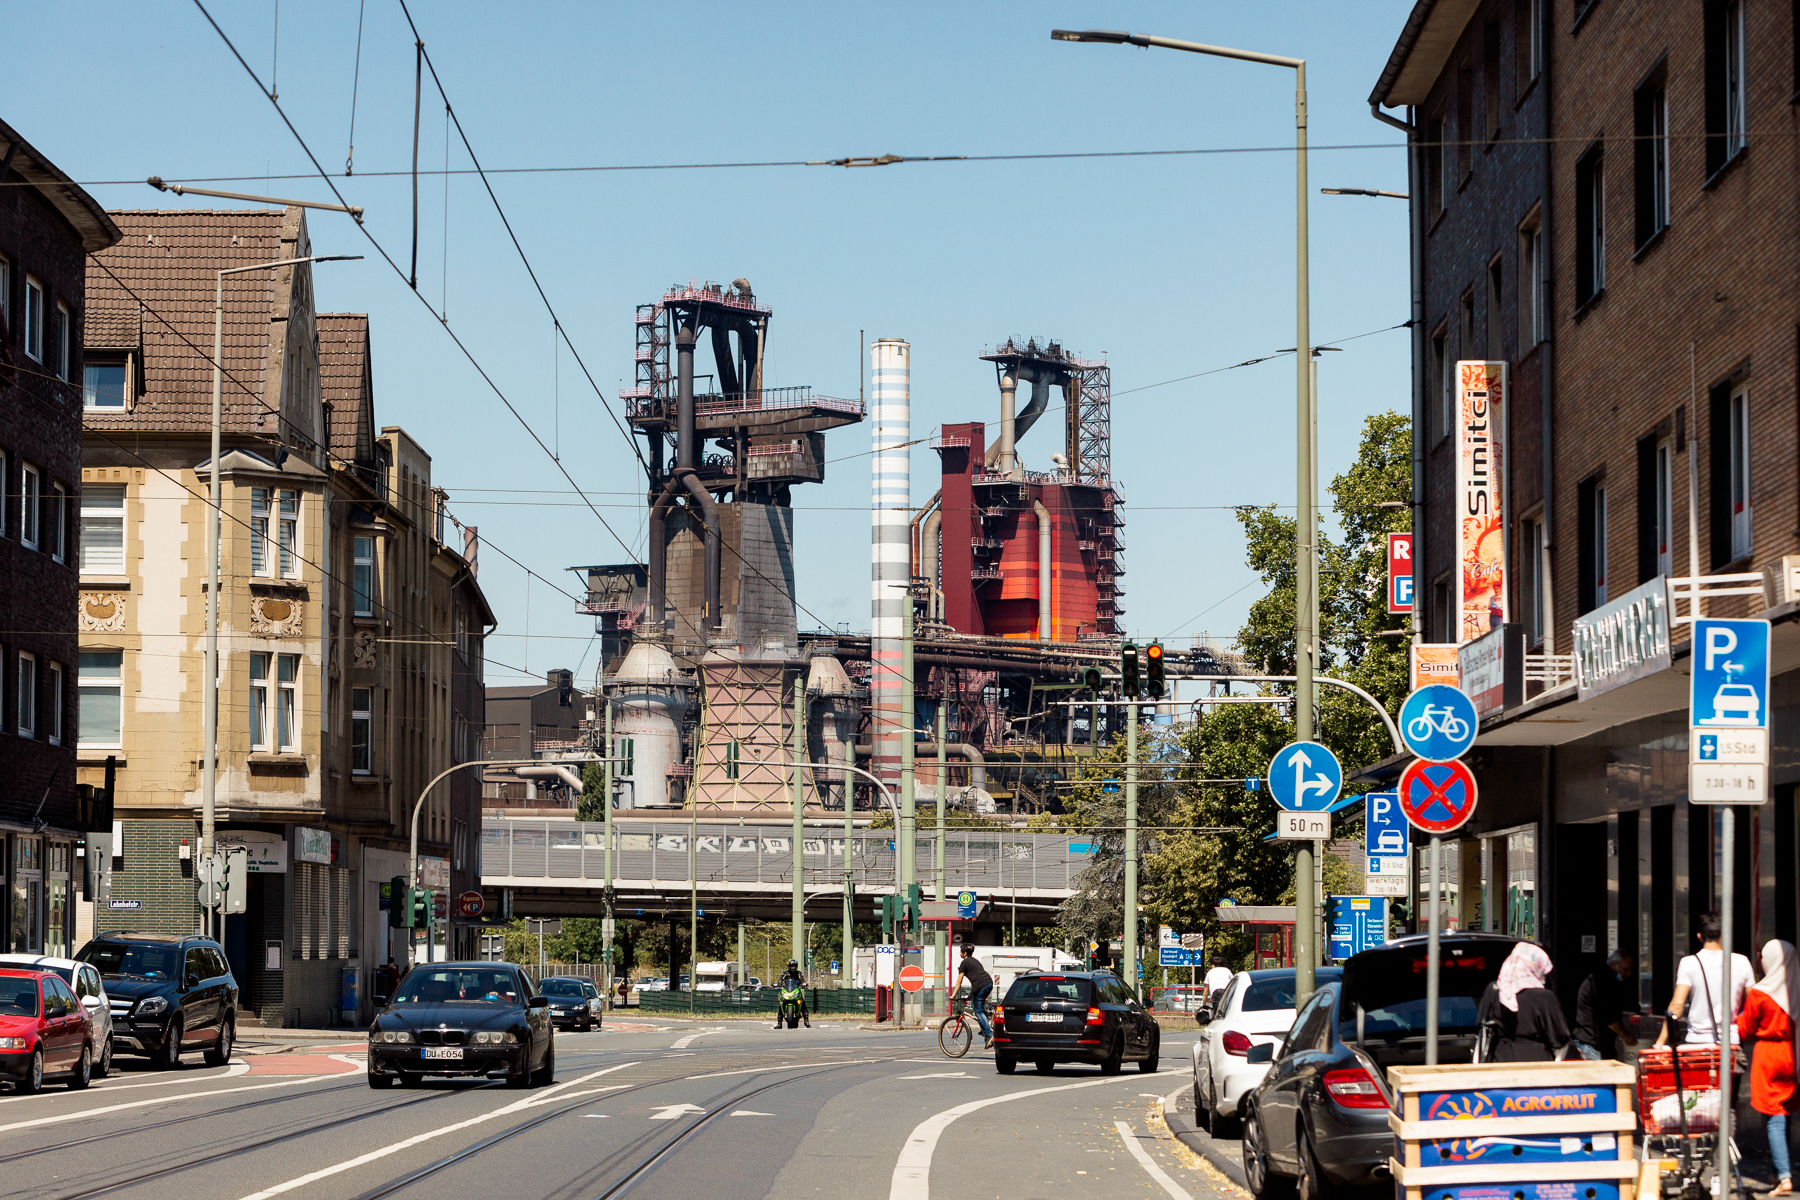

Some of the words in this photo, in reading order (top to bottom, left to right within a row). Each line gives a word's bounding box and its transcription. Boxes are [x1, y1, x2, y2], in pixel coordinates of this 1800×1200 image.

[1468, 391, 1487, 516] Simitci
[1705, 627, 1737, 671] P
[1372, 797, 1392, 822] P
[1290, 818, 1306, 832] 50
[1310, 822, 1324, 832] m
[1369, 876, 1405, 886] werktags
[426, 1050, 437, 1058] DU
[1503, 1094, 1597, 1112] AGROFRUT
